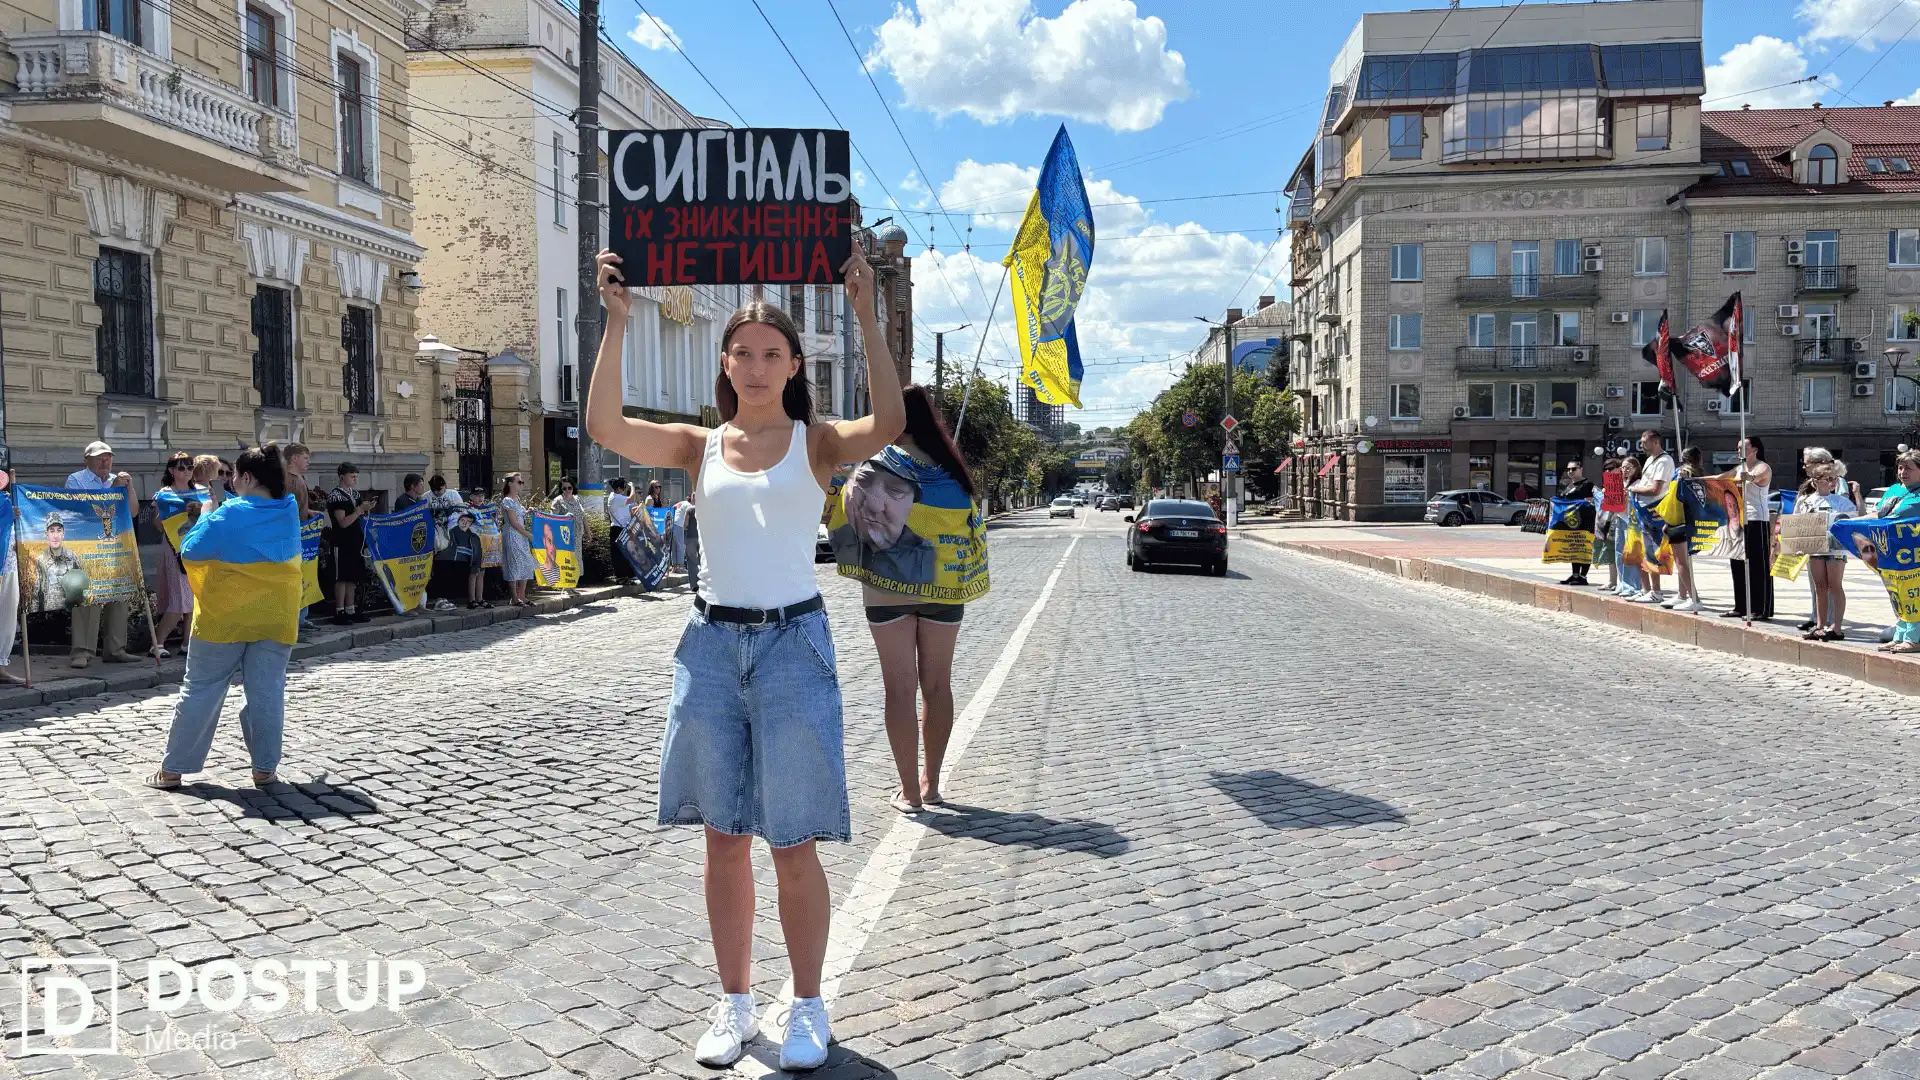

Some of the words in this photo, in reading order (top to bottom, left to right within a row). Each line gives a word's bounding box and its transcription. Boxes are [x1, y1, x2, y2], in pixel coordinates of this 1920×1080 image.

[613, 130, 850, 203] СИГНАЛЬ
[622, 205, 653, 240] ЇХ
[647, 242, 697, 285] НЕ
[706, 240, 833, 284] ТИША
[1905, 603, 1918, 615] 34
